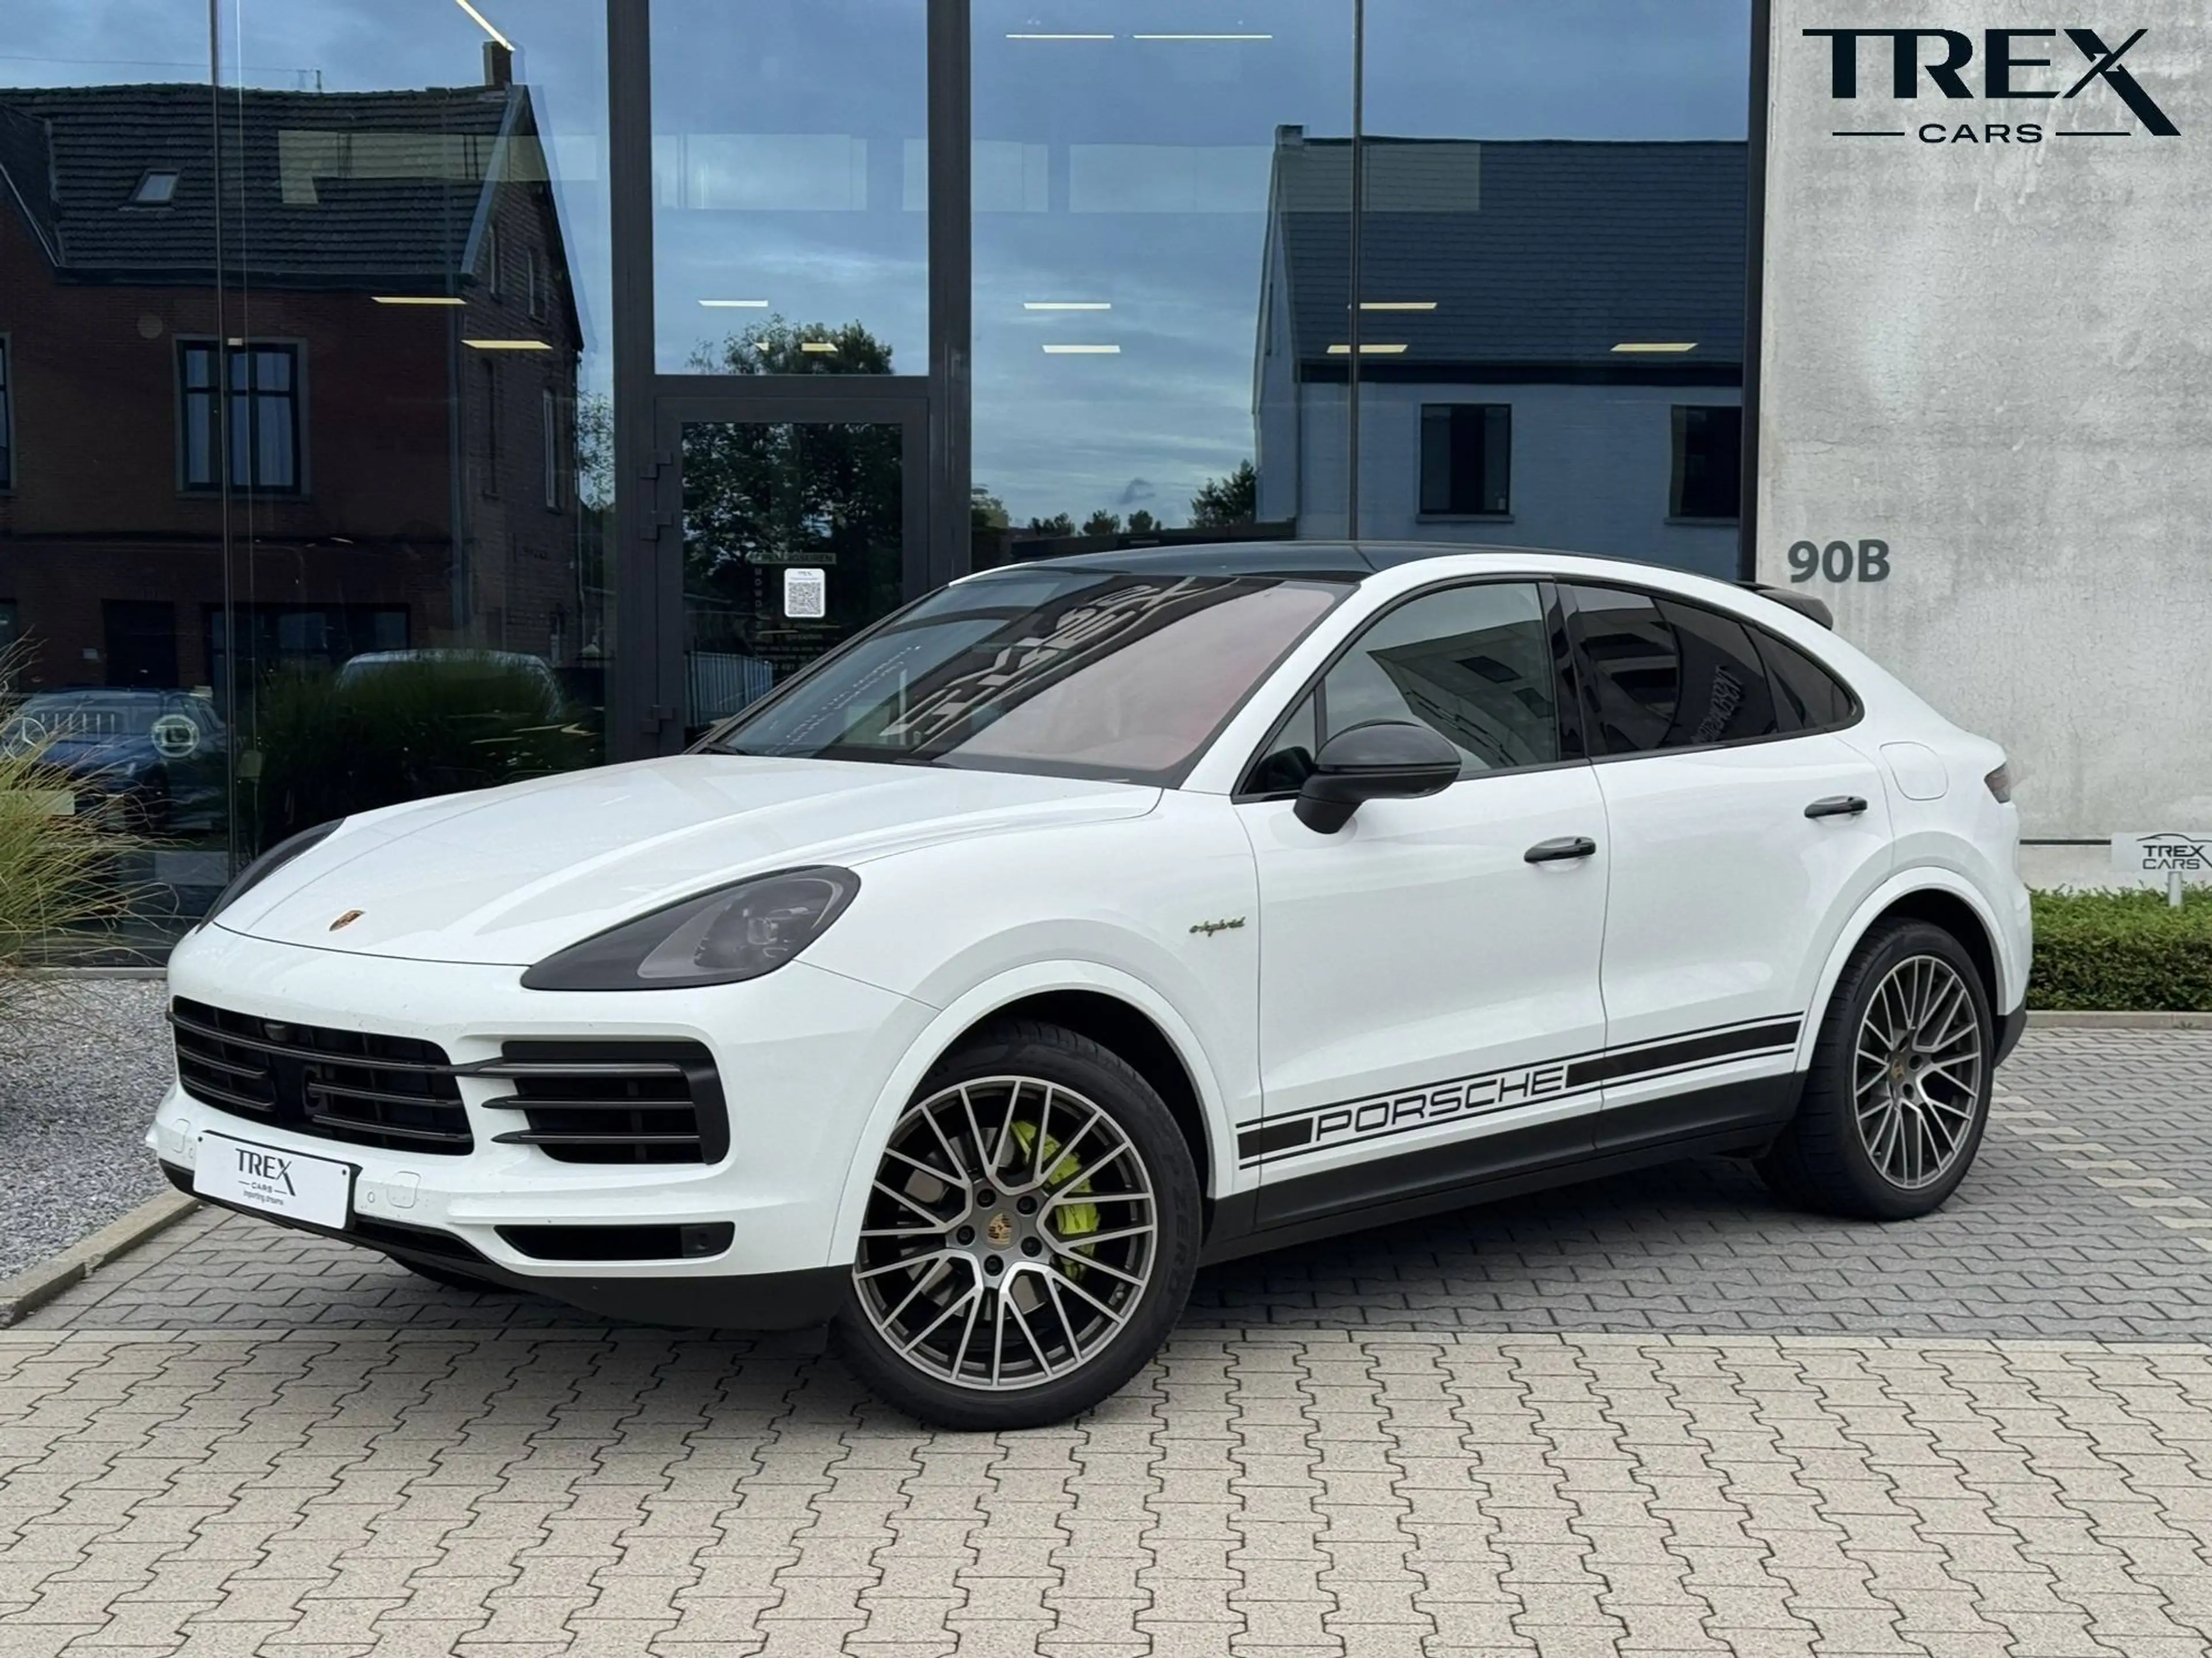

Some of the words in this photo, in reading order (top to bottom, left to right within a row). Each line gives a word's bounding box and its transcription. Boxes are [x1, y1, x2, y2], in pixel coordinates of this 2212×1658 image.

[1788, 540, 1891, 583] 90B
[2143, 845, 2212, 866] TREX
[2143, 859, 2200, 870] CARS
[1316, 1065, 1565, 1141] PORSCHE
[236, 1148, 296, 1196] TREX
[251, 1182, 273, 1193] CARS
